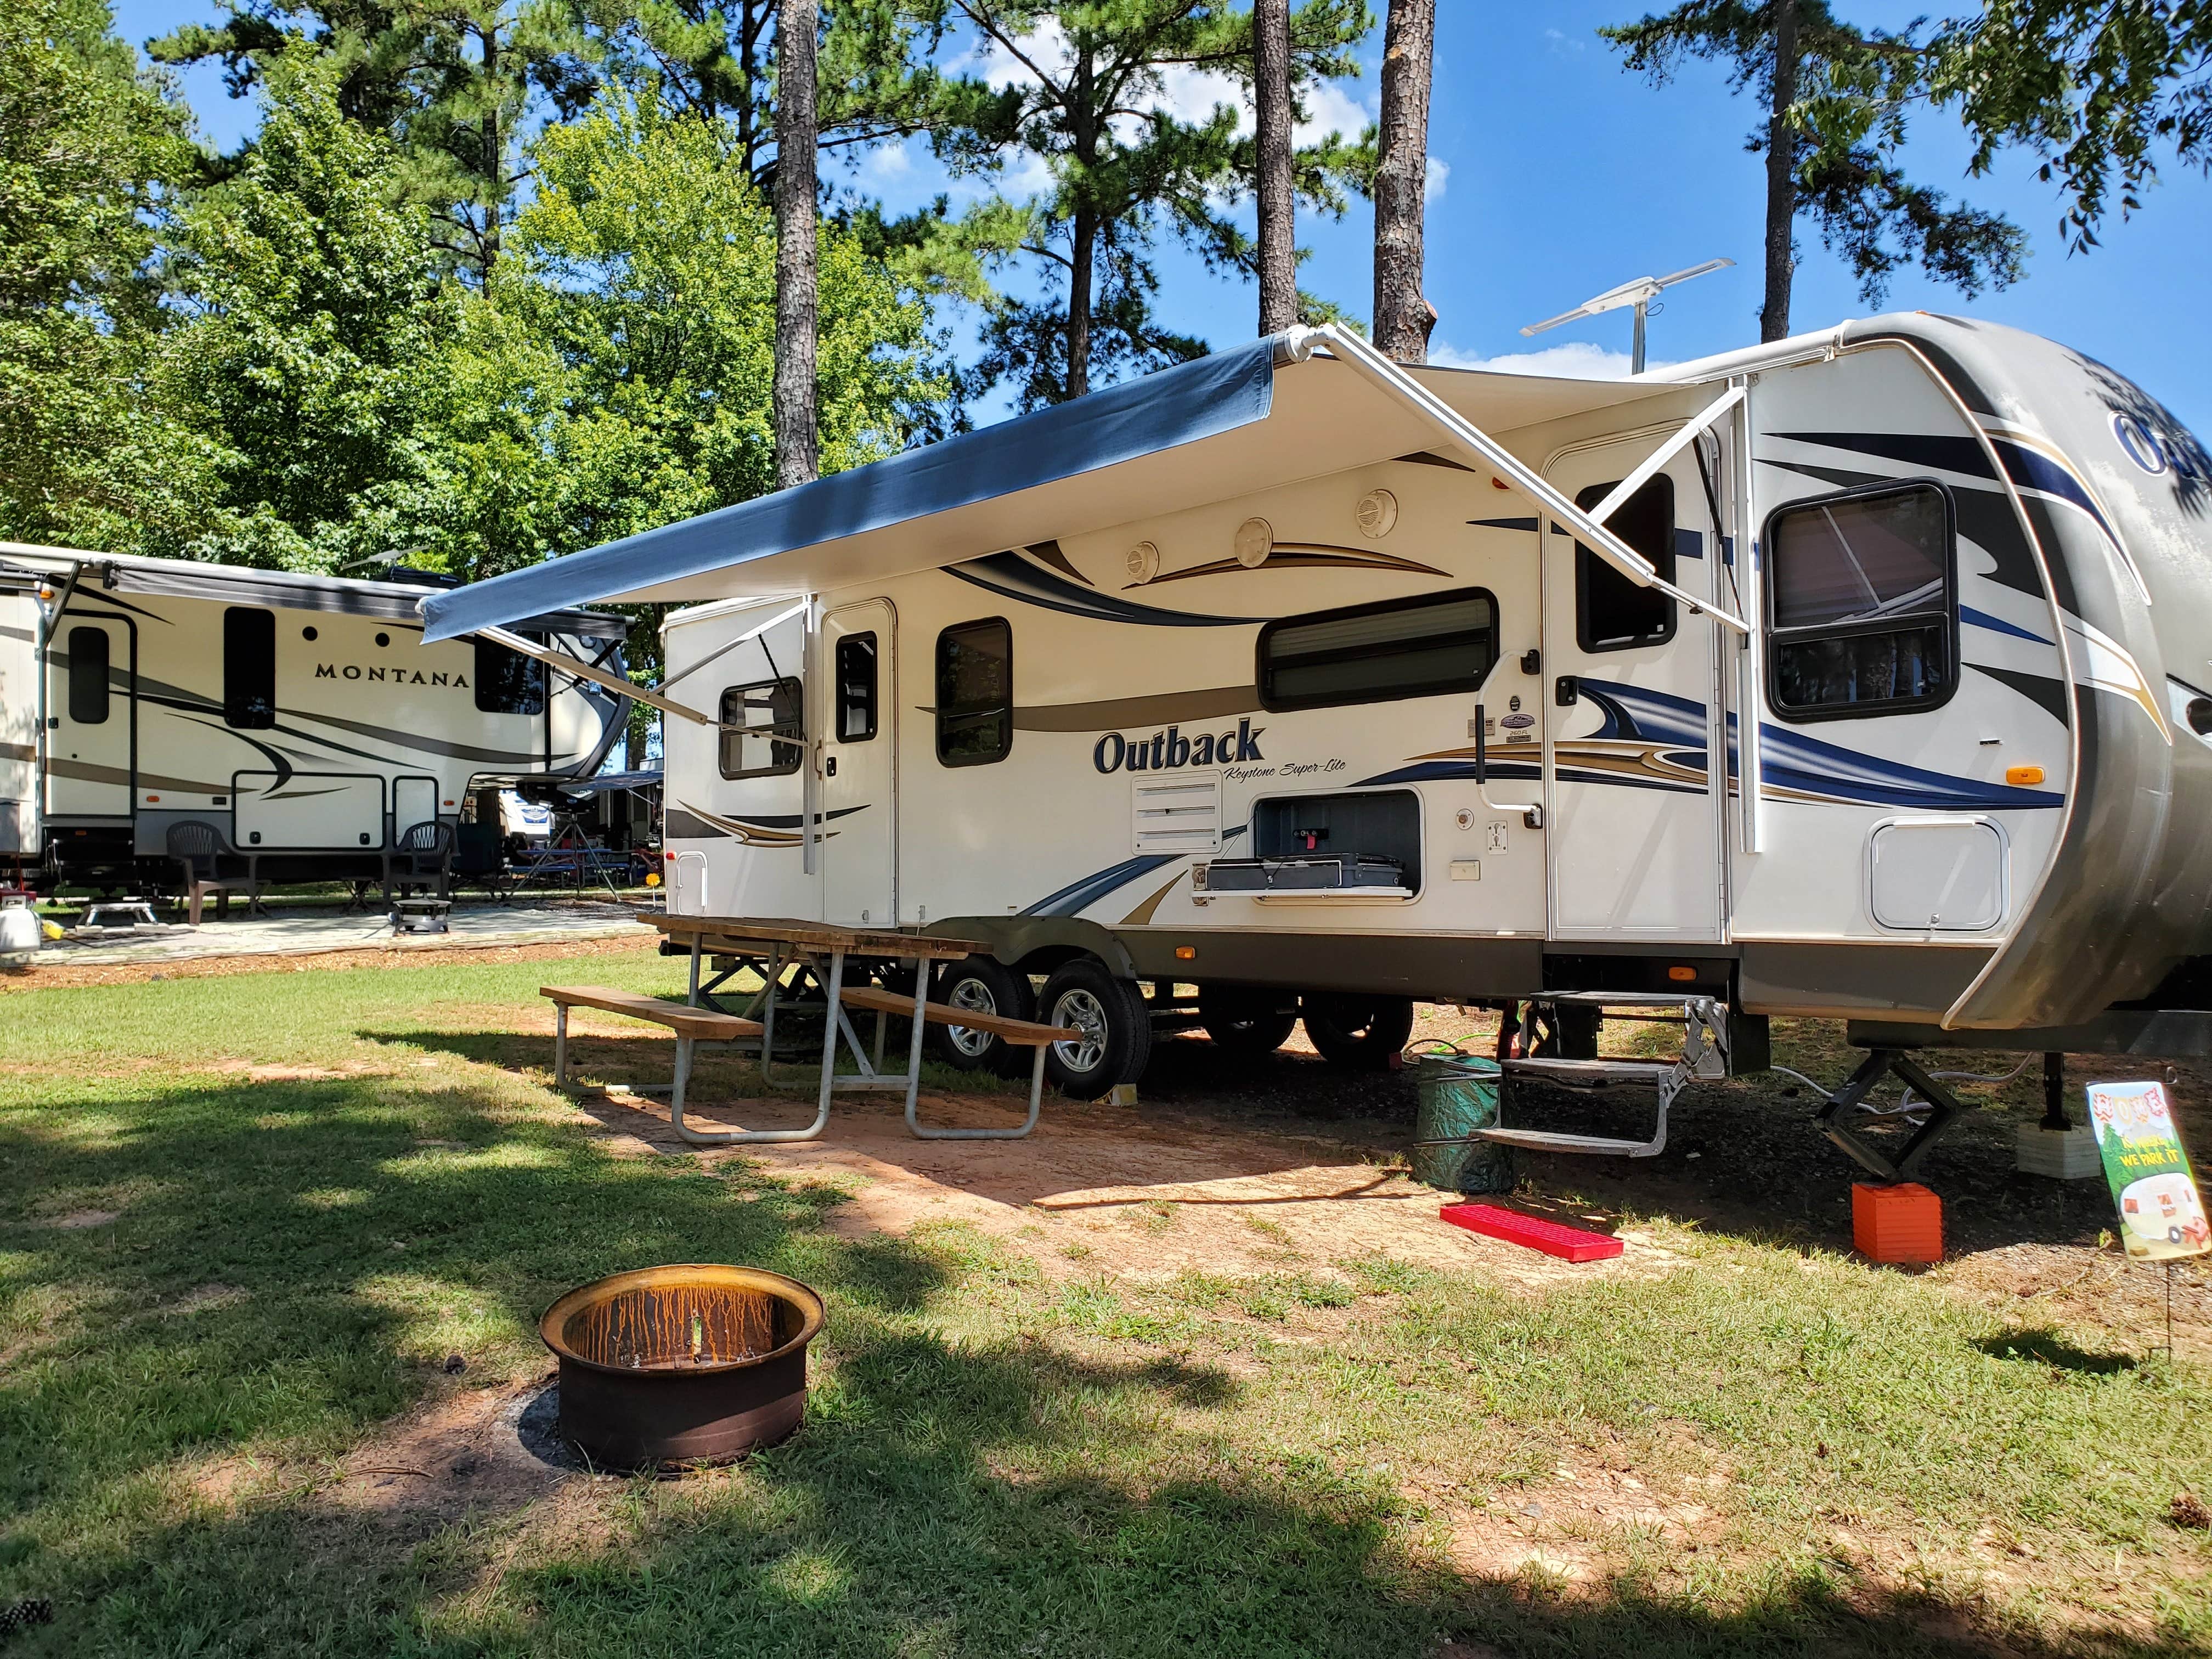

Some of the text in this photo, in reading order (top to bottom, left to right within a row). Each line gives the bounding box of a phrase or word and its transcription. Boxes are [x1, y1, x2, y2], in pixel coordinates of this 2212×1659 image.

[315, 663, 470, 688] MONTANA
[1093, 716, 1267, 775] Outback
[1223, 758, 1347, 784] Keystone Super-Lite
[2095, 1090, 2165, 1121] HOME
[2119, 1154, 2140, 1167] WE
[2140, 1152, 2166, 1167] PARK
